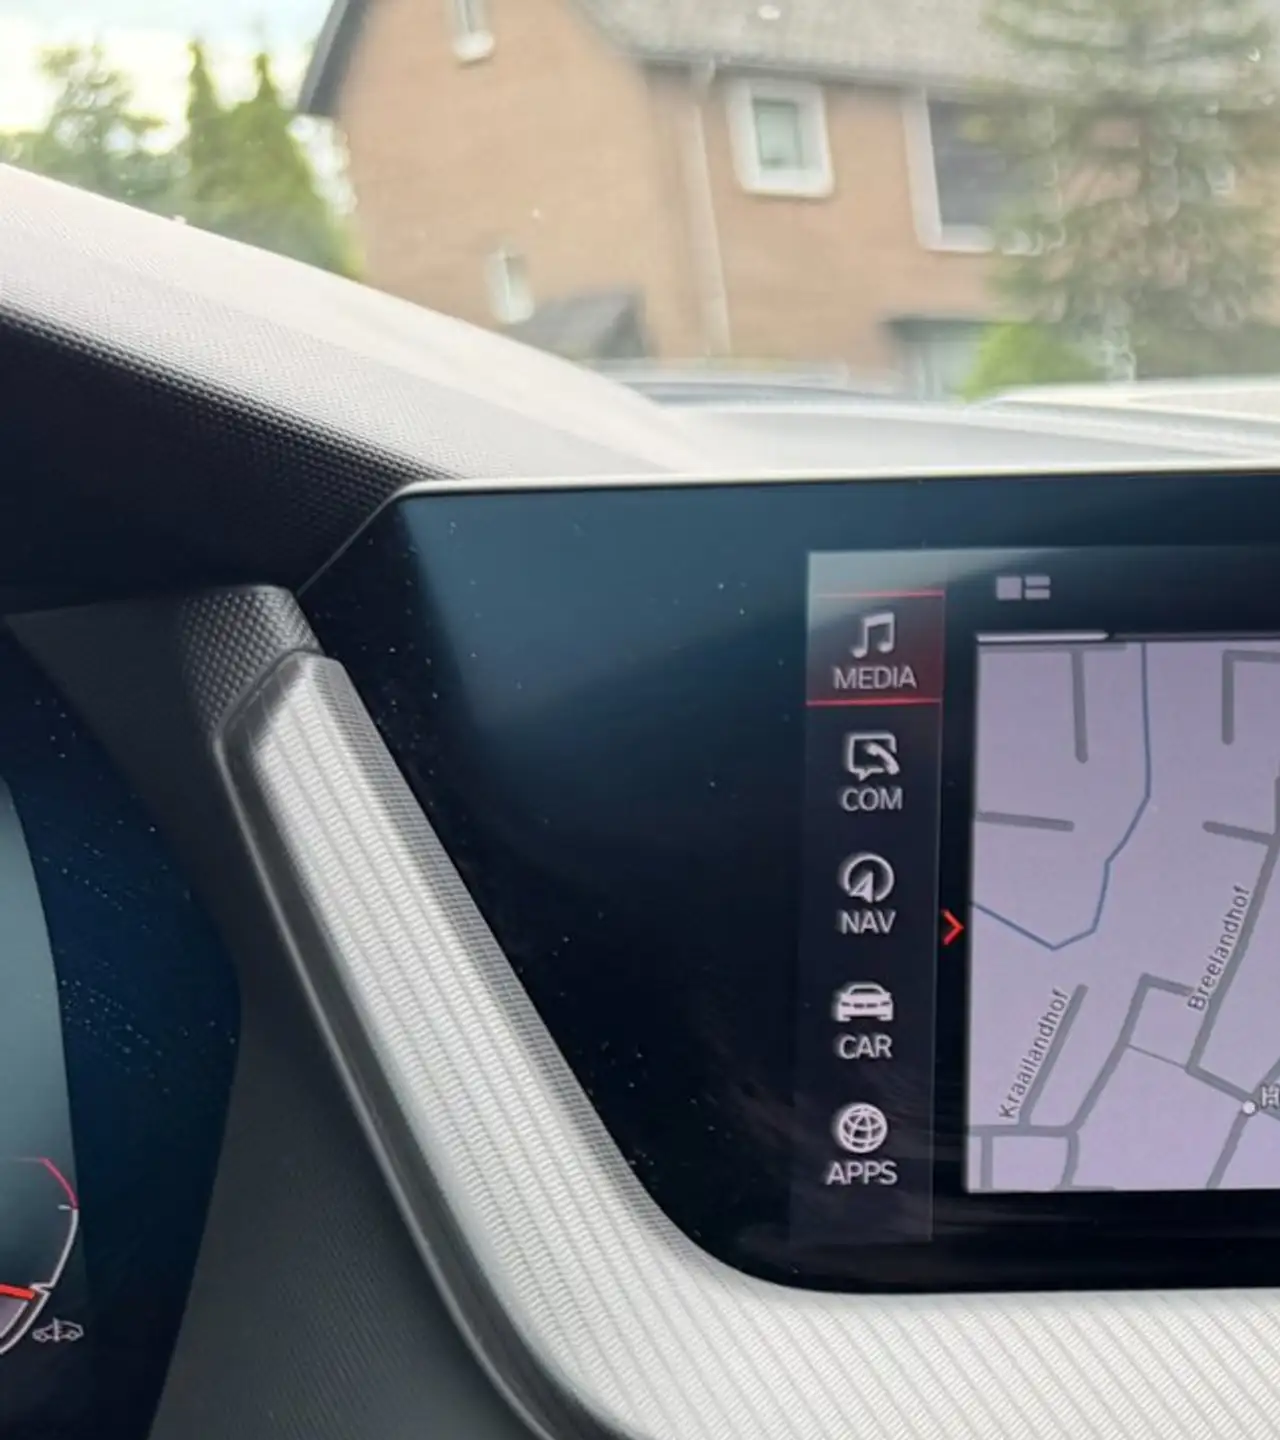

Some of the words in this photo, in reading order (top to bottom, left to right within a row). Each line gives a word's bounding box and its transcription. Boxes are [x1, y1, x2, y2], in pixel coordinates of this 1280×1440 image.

[833, 665, 917, 690] MEDIA
[841, 788, 903, 811] COM
[839, 911, 897, 934] NAV
[1187, 885, 1251, 1012] Breelandhof
[838, 1035, 893, 1059] CAR
[998, 988, 1069, 1119] Kraailandhof
[825, 1161, 898, 1185] APPS
